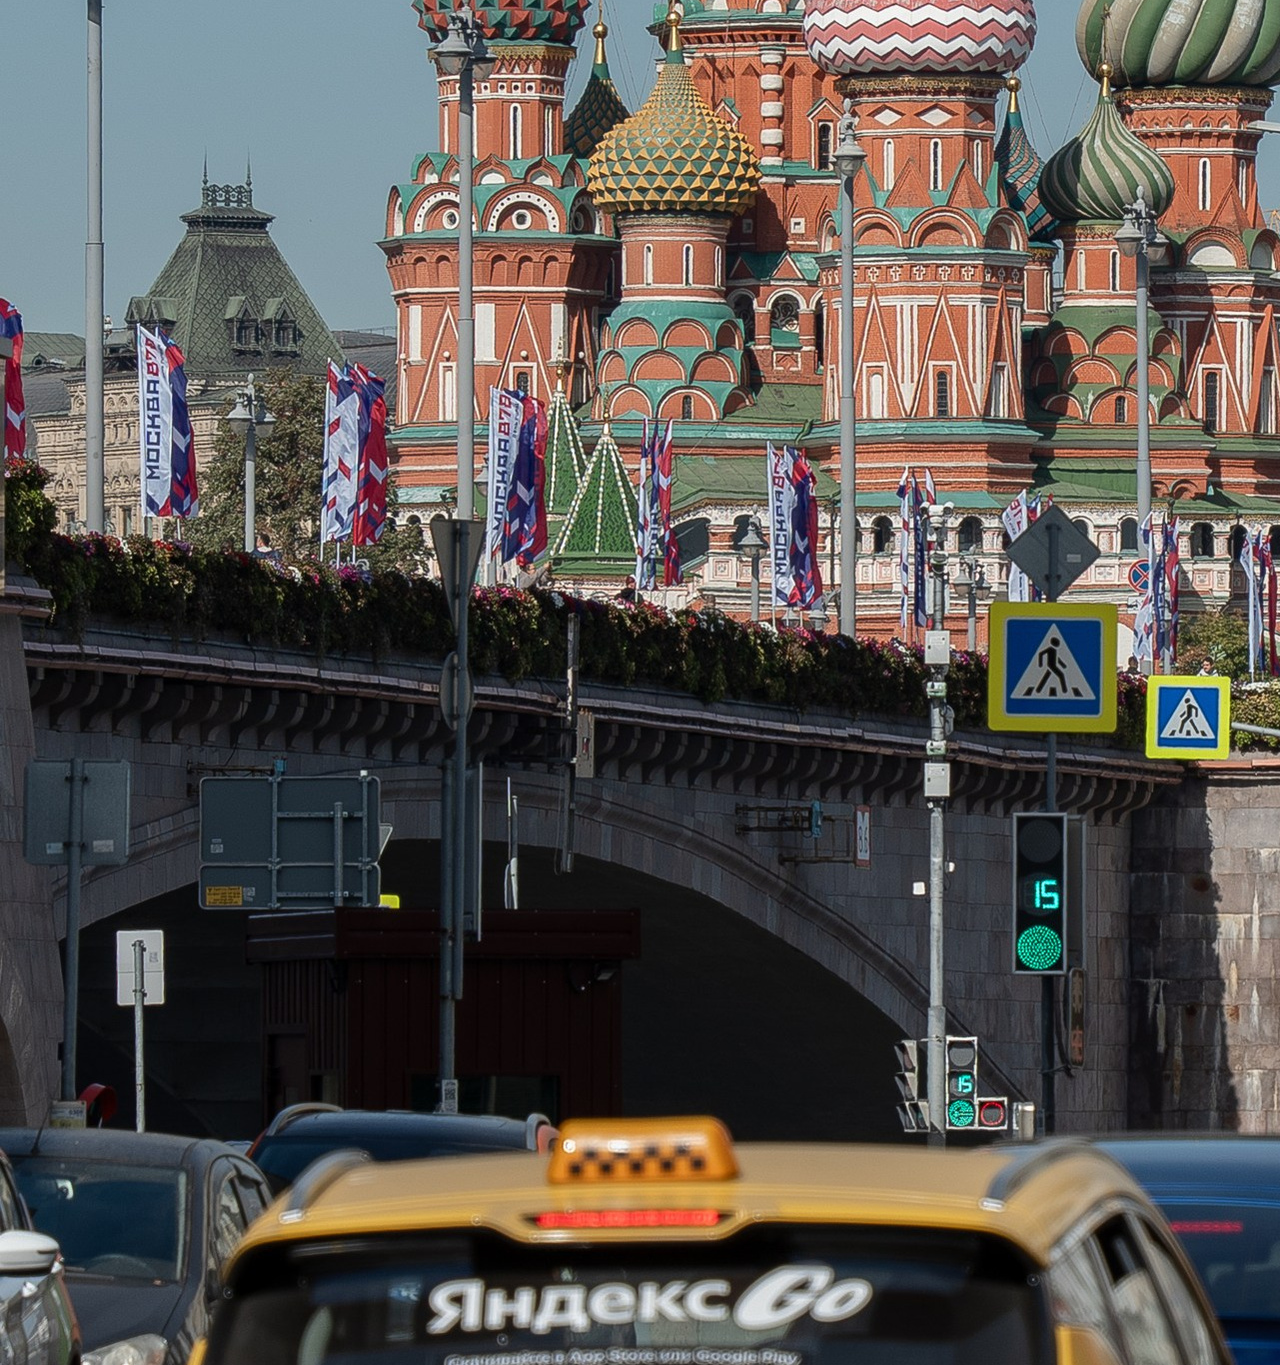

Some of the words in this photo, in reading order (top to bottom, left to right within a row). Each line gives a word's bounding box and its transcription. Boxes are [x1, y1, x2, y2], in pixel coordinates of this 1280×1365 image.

[146, 379, 161, 480] МОСКВА
[498, 394, 512, 437] 878
[1034, 879, 1060, 910] 15
[957, 1074, 973, 1093] 15
[427, 1278, 731, 1334] Яндекс
[733, 1265, 873, 1330] Go
[608, 1348, 654, 1364] Store
